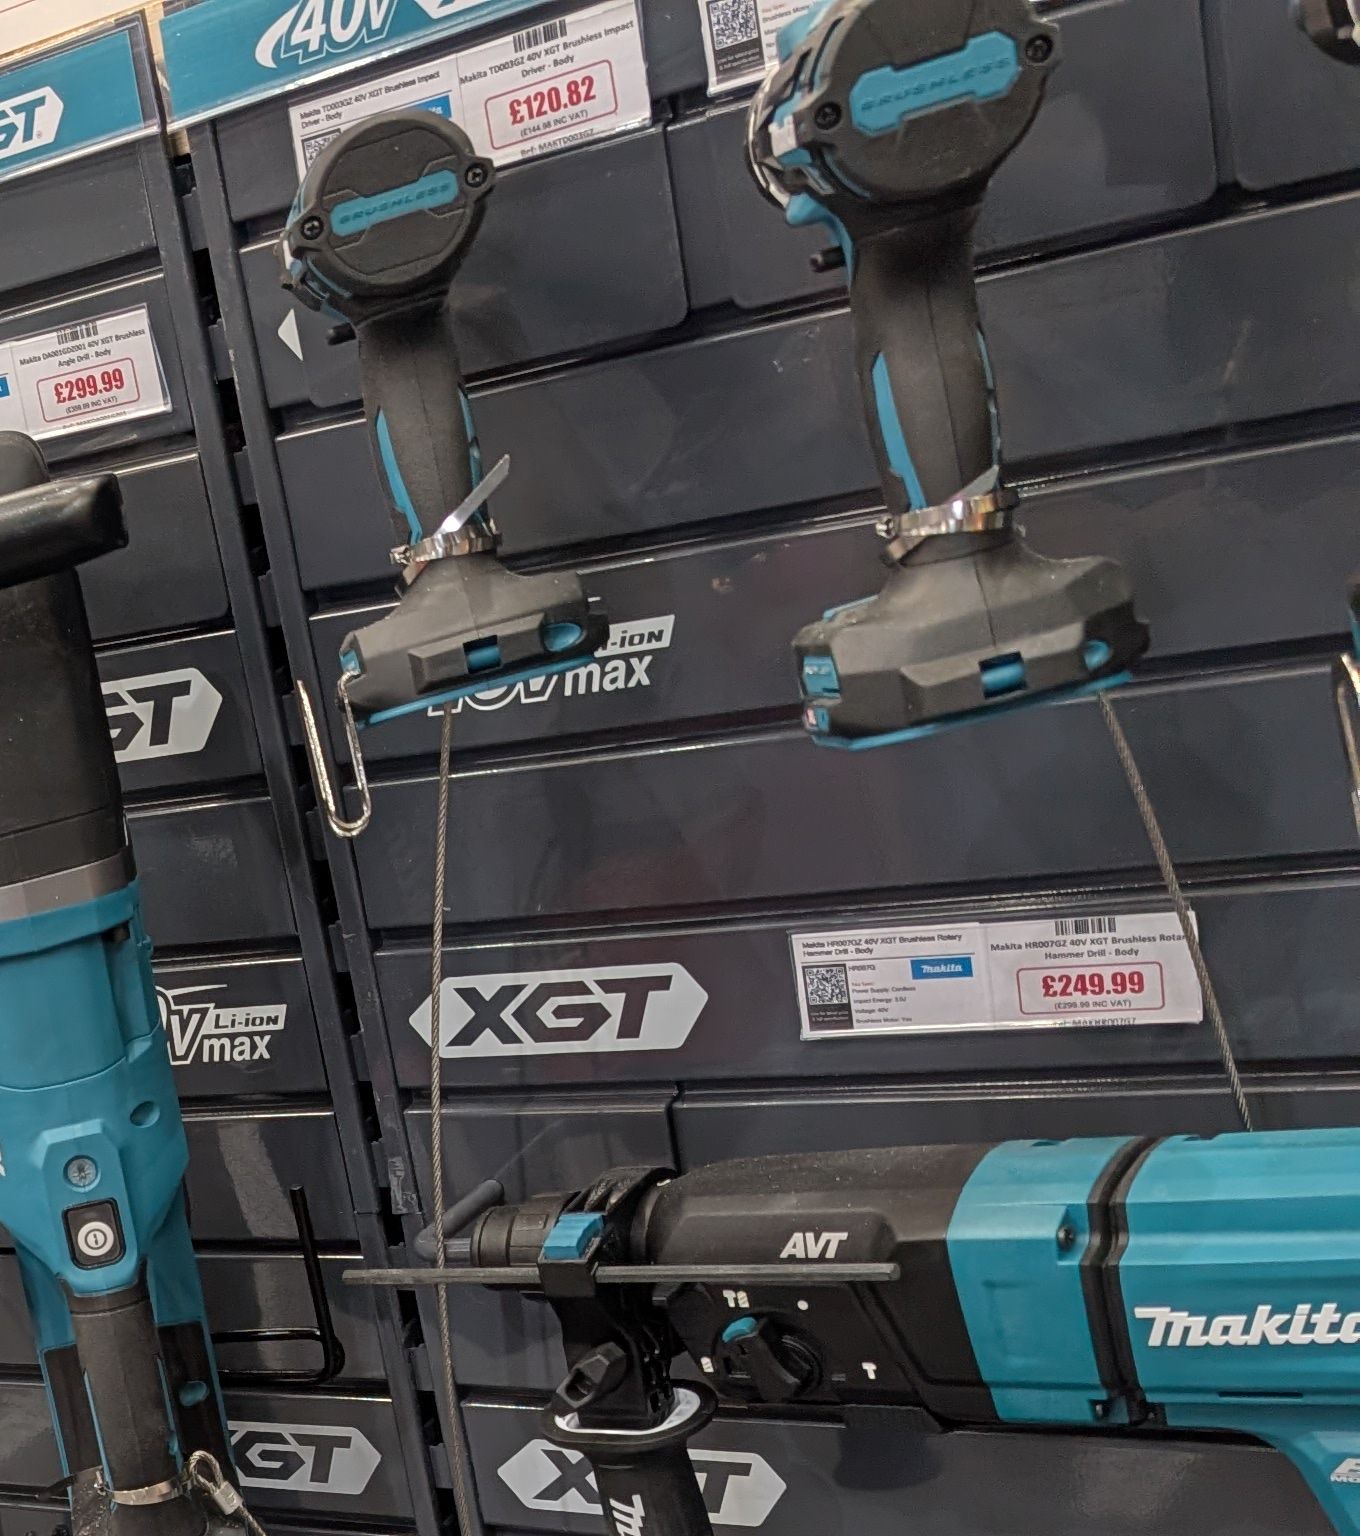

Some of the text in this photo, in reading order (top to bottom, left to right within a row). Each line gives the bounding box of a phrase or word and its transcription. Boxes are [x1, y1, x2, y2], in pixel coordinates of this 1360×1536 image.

[460, 19, 636, 85] Makita TD003GZ 40V XGT Brushless Impact
[415, 71, 441, 87] Impact
[520, 55, 575, 80] Driver Body
[508, 74, 597, 126] £120.82
[551, 114, 567, 129] INC
[567, 108, 589, 124] VAT)
[19, 352, 42, 367] Makita
[100, 335, 114, 347] XGT
[114, 327, 146, 344] Brushless
[58, 347, 112, 369] Angle Drill Body
[54, 366, 125, 405] £299.99
[564, 654, 653, 697] max
[107, 680, 192, 750] GT
[936, 933, 963, 945] Rotary
[990, 933, 1186, 952] Makita HR007GZ 40V XGT Brushless Rotar
[1044, 947, 1139, 961] Hammer Drill Body
[1041, 970, 1145, 999] £249.99
[446, 973, 674, 1048] XGT
[1091, 999, 1107, 1009] INC
[1108, 998, 1132, 1009] VAT)
[213, 1010, 280, 1031] Li-ion
[203, 1034, 271, 1061] max
[779, 1231, 849, 1259] AVT
[231, 1430, 352, 1486] GT
[532, 1448, 752, 1514] XT
